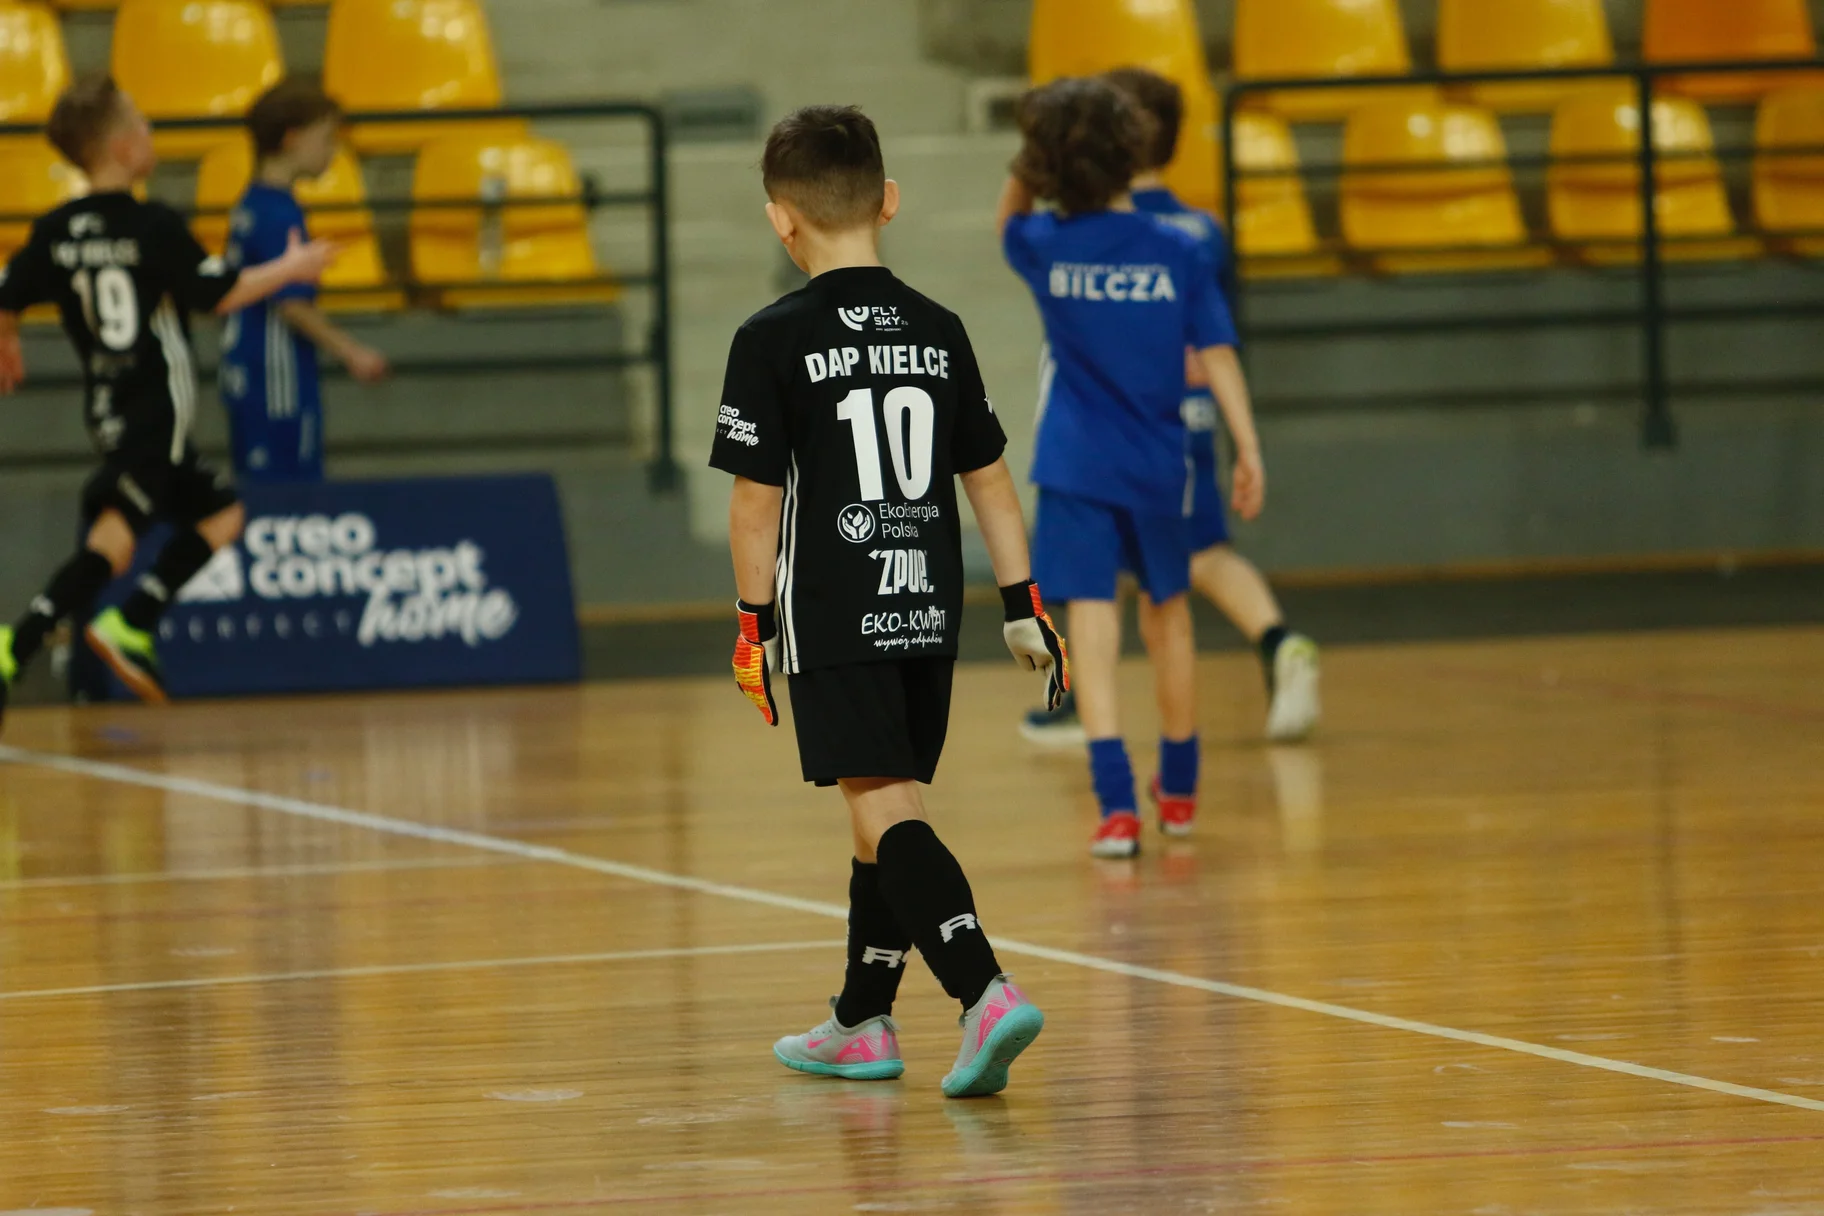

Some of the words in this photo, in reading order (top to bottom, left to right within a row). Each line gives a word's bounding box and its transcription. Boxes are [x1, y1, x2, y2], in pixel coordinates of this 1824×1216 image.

[71, 267, 140, 350] 19
[871, 306, 898, 316] FLY
[873, 316, 900, 326] SKY
[804, 347, 860, 383] DAP
[867, 344, 949, 380] KIELCE
[717, 414, 757, 434] concept
[726, 426, 760, 447] home
[836, 386, 935, 502] 10
[245, 513, 376, 556] creo
[881, 521, 919, 539] Polska
[248, 539, 487, 599] concept
[356, 587, 520, 647] home
[861, 605, 946, 635] EKO-KWIAT
[873, 634, 909, 652] wywóz
